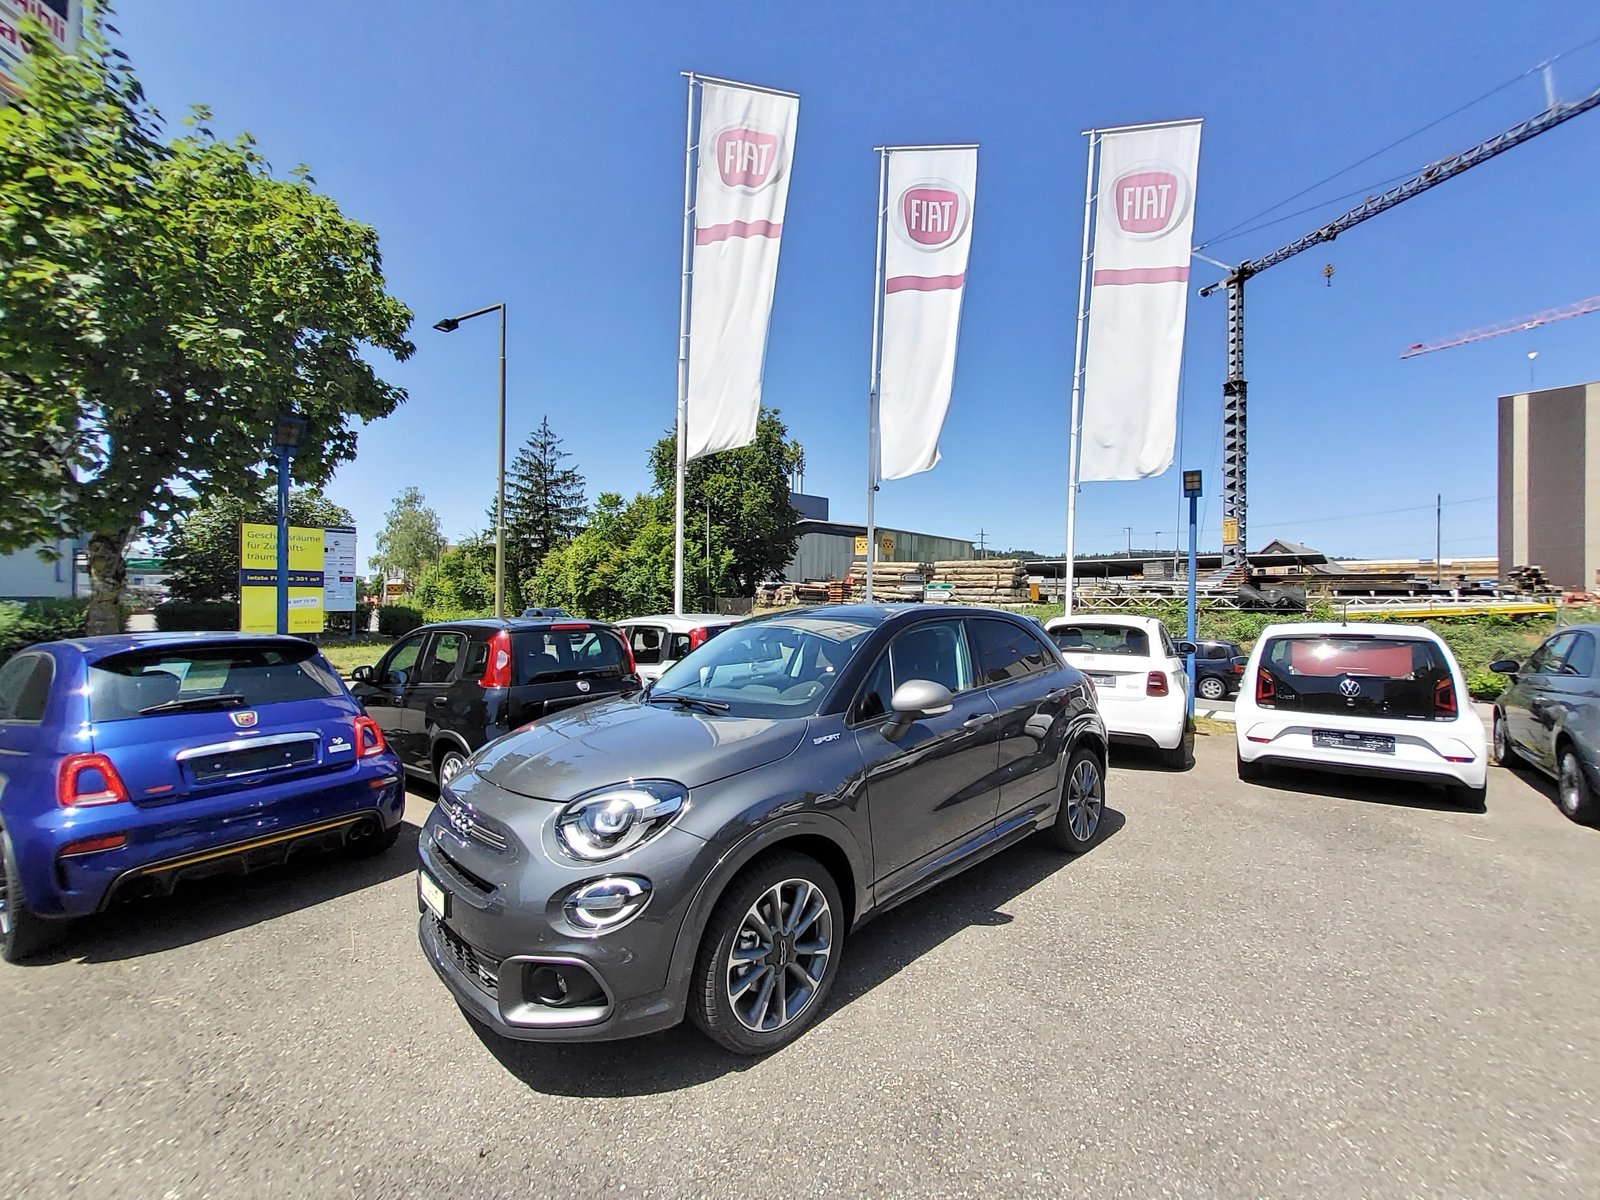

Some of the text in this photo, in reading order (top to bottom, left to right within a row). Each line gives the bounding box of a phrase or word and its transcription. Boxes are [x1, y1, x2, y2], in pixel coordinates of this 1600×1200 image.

[724, 140, 772, 176] FIAT
[911, 199, 954, 233] FIAT
[1123, 184, 1172, 221] FIAT
